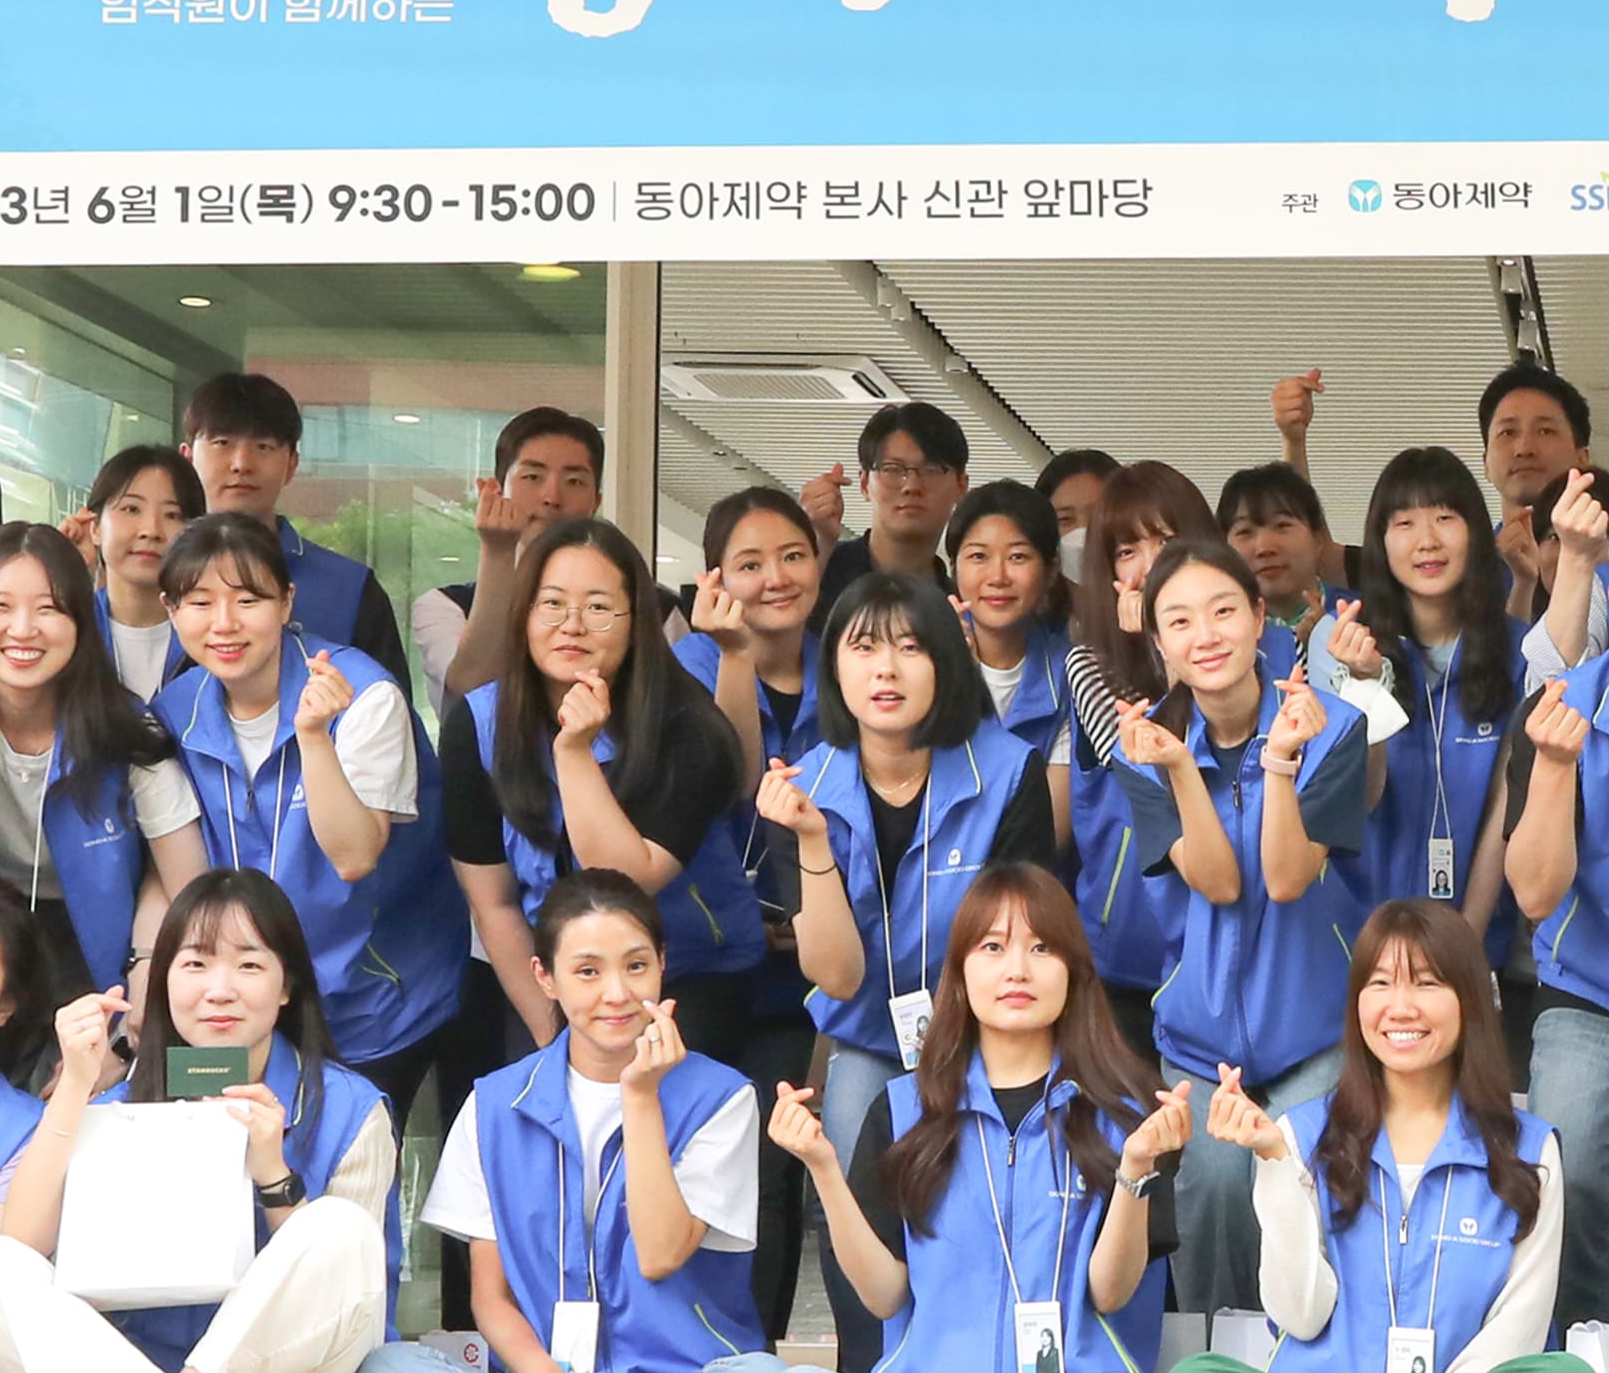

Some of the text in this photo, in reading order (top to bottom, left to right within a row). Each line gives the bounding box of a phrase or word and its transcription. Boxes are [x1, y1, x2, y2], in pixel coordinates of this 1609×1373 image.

[88, 186, 155, 224] 6월
[175, 184, 312, 223] 1일(목)
[636, 181, 807, 220] 동아제약
[823, 181, 907, 219] 본사
[925, 180, 1008, 218] 신관
[1024, 179, 1152, 218] 앞마당
[1283, 182, 1532, 212] 주관 동아제약
